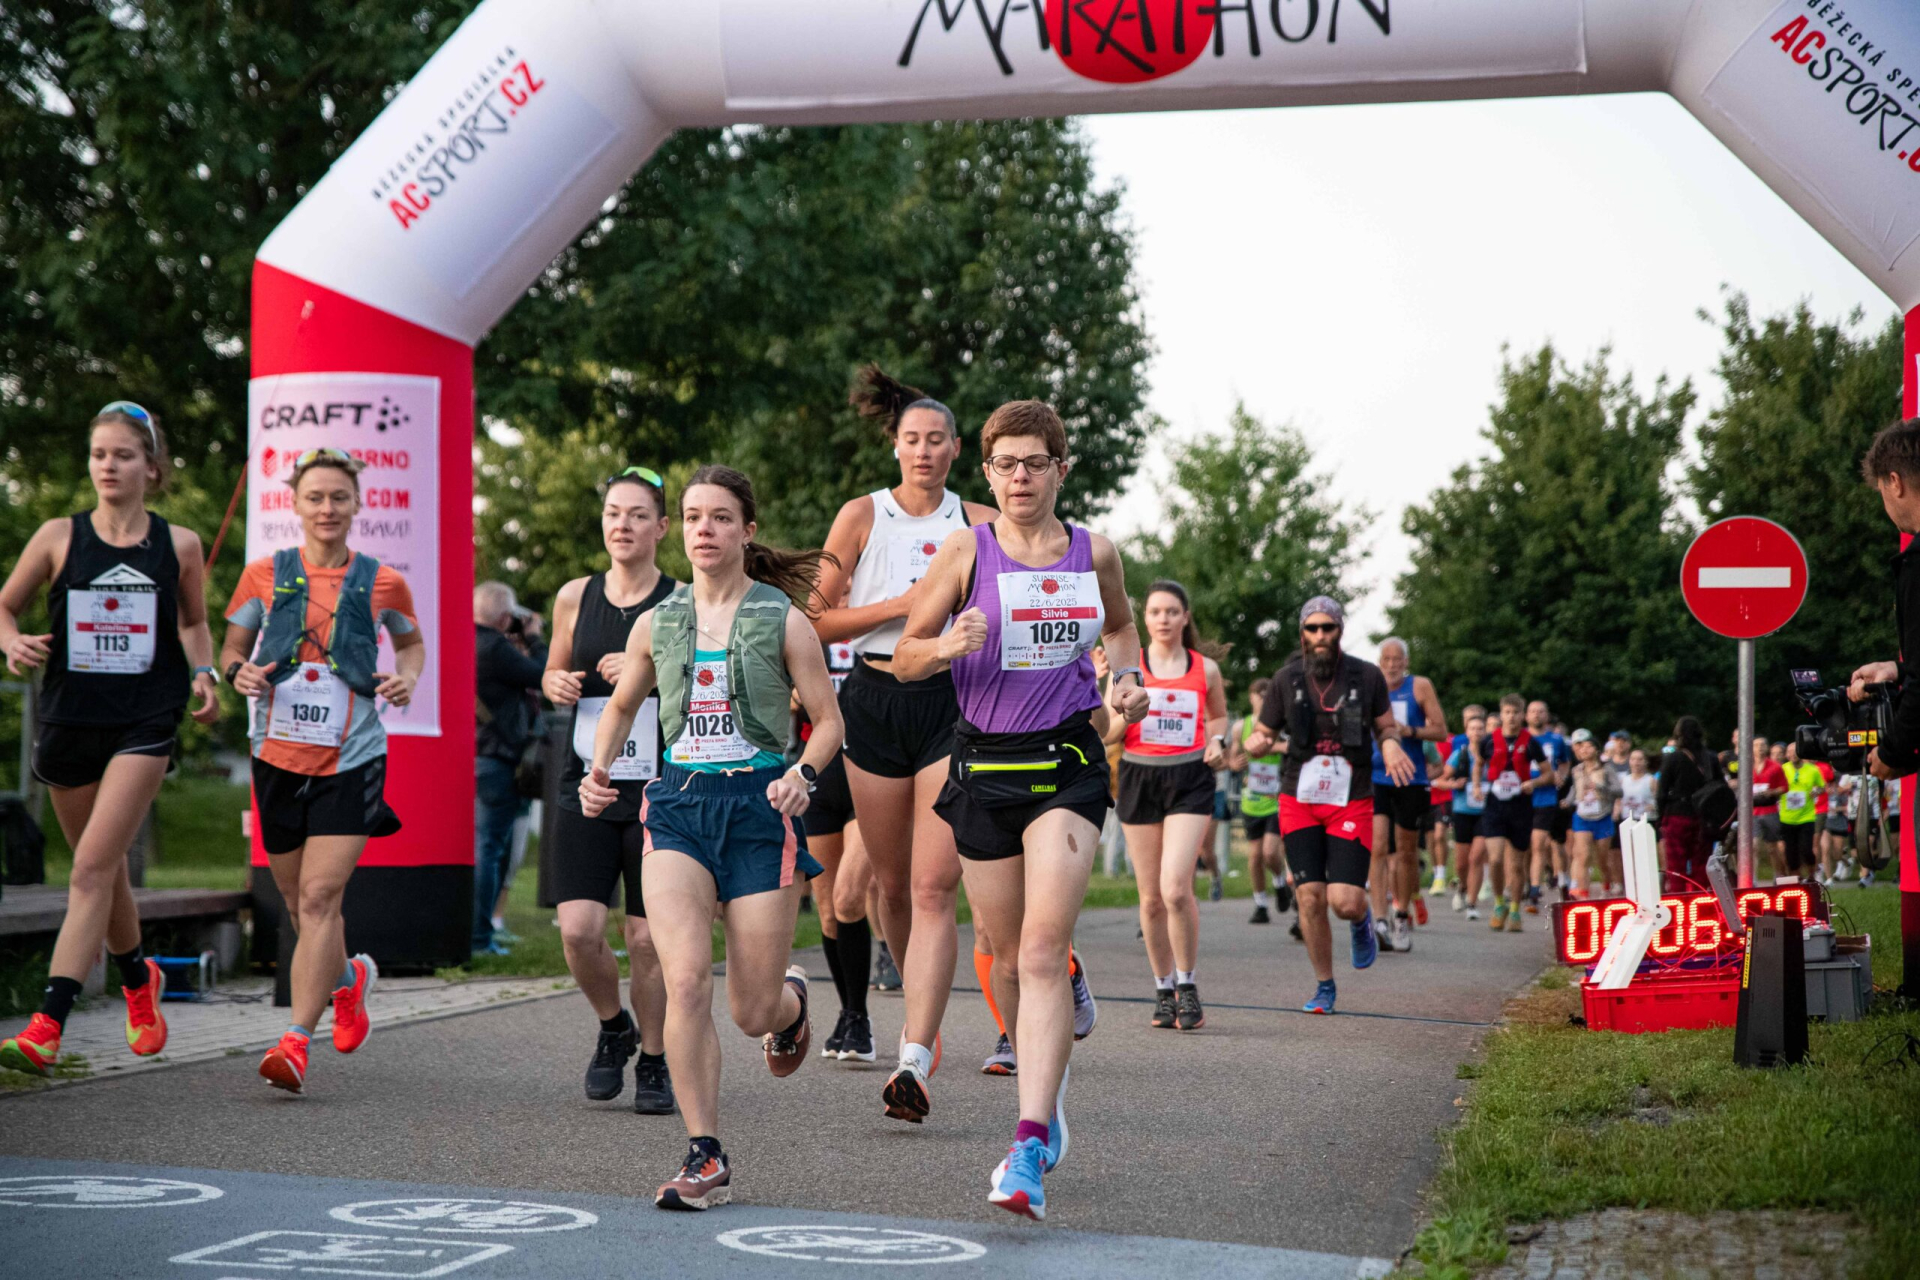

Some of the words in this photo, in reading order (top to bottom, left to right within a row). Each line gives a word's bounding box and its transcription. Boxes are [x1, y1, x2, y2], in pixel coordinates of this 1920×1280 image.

[1886, 68, 1920, 110] SPE
[389, 60, 545, 229] ACSPORT.CZ
[262, 404, 372, 429] CRAFT
[1032, 574, 1068, 582] SUNRISE
[1029, 598, 1078, 607] 22/6/2025
[1041, 609, 1069, 619] Silvie
[1030, 621, 1080, 644] 1029
[93, 634, 130, 652] 1113
[694, 665, 724, 674] UNRISE
[291, 703, 330, 724] 1307
[691, 701, 727, 712] Monika
[687, 713, 735, 738] 1028
[1157, 718, 1183, 731] 1106
[1319, 780, 1331, 791] 97
